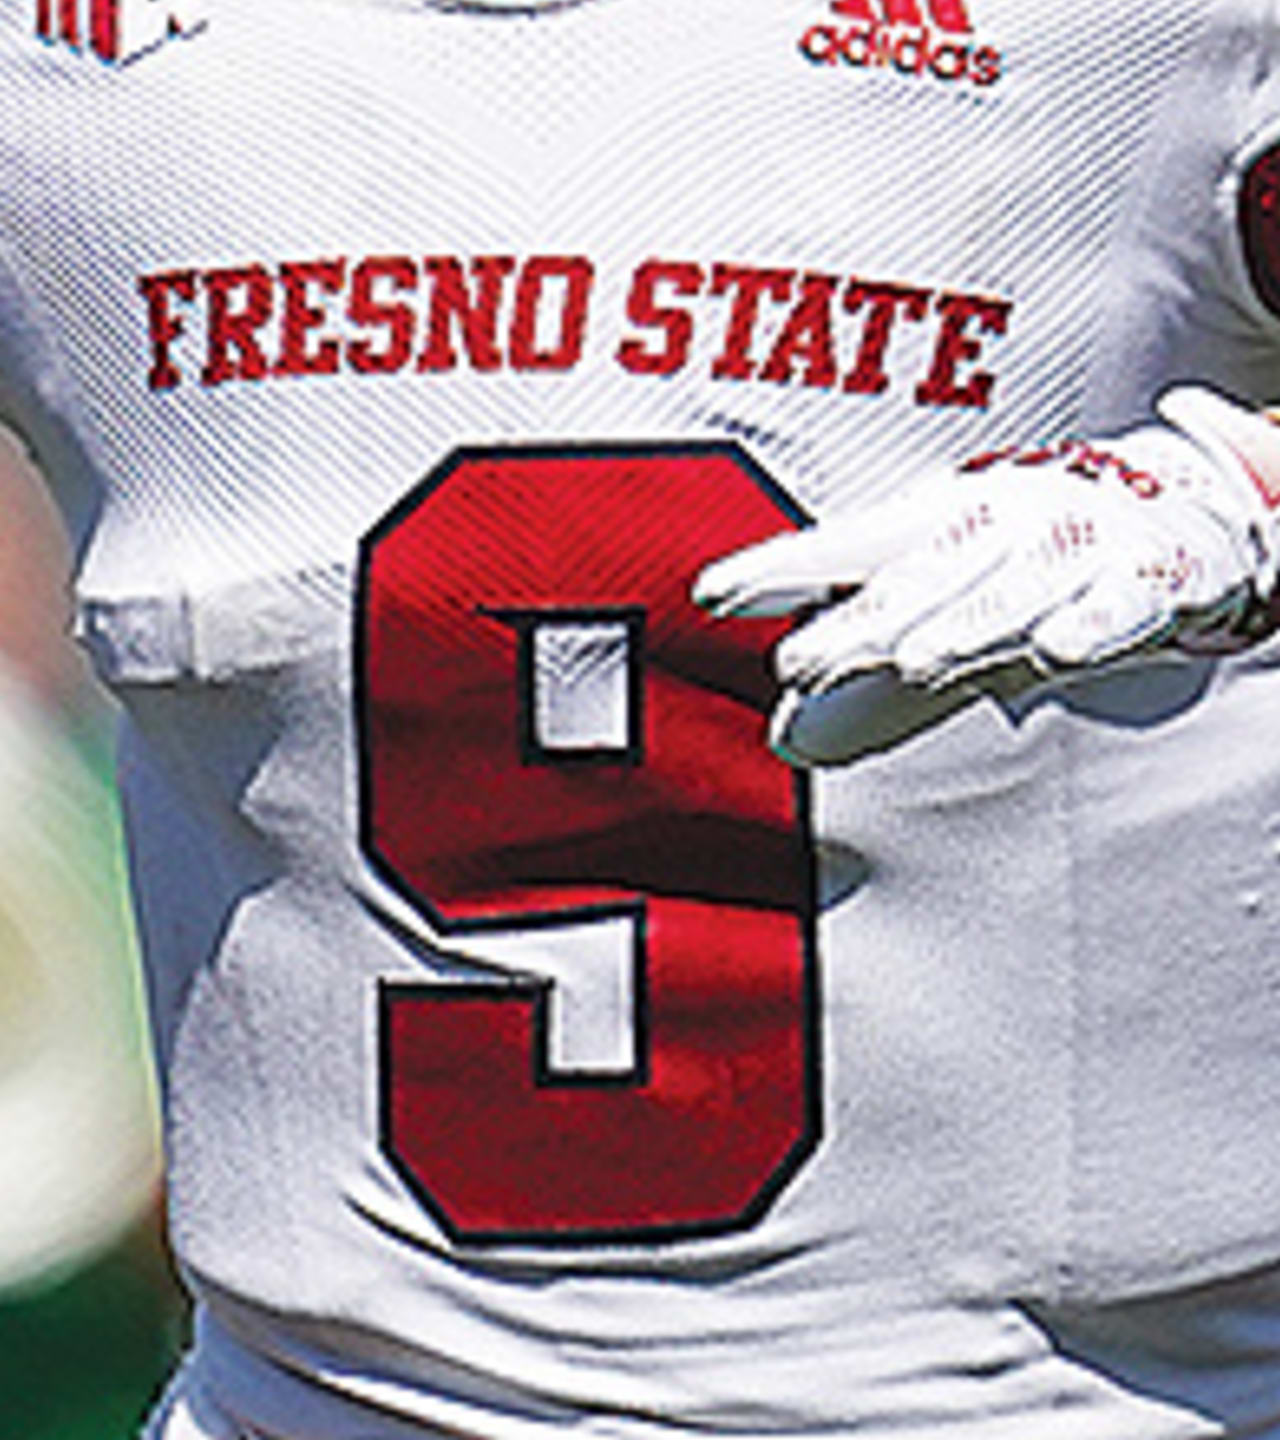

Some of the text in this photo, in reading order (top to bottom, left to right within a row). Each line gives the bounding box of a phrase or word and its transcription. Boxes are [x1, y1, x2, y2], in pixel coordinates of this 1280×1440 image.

[798, 22, 1002, 86] adidas
[137, 256, 1013, 412] FRESNO STATE
[353, 440, 823, 1247] 9
